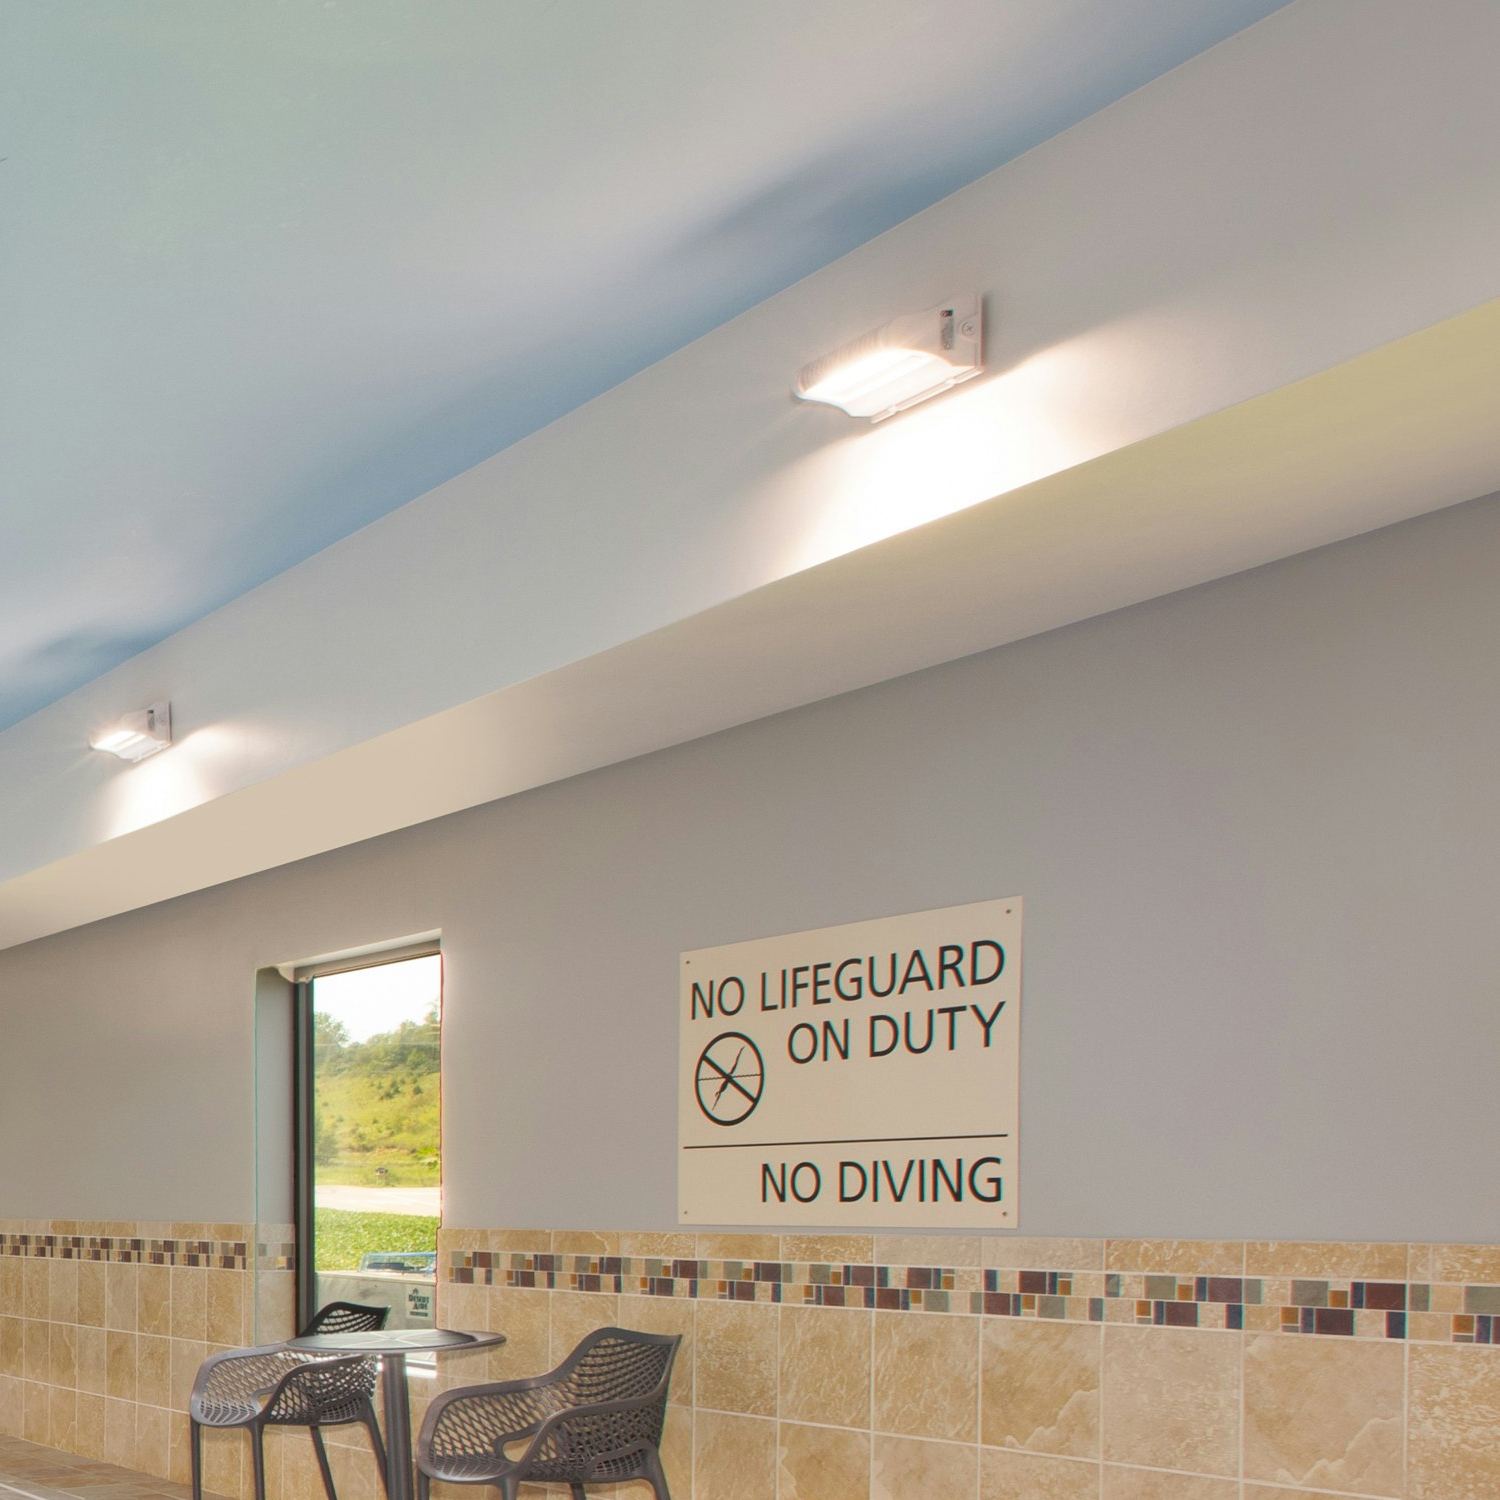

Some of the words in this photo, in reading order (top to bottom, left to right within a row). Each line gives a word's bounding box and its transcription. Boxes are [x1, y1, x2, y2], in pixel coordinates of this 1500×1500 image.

[691, 976, 745, 1020] NO
[760, 939, 1006, 1011] LIFEGUARD
[787, 1019, 850, 1064] ON
[868, 1001, 1006, 1058] DUTY
[761, 1161, 822, 1203] NO
[838, 1157, 1003, 1203] DIVING
